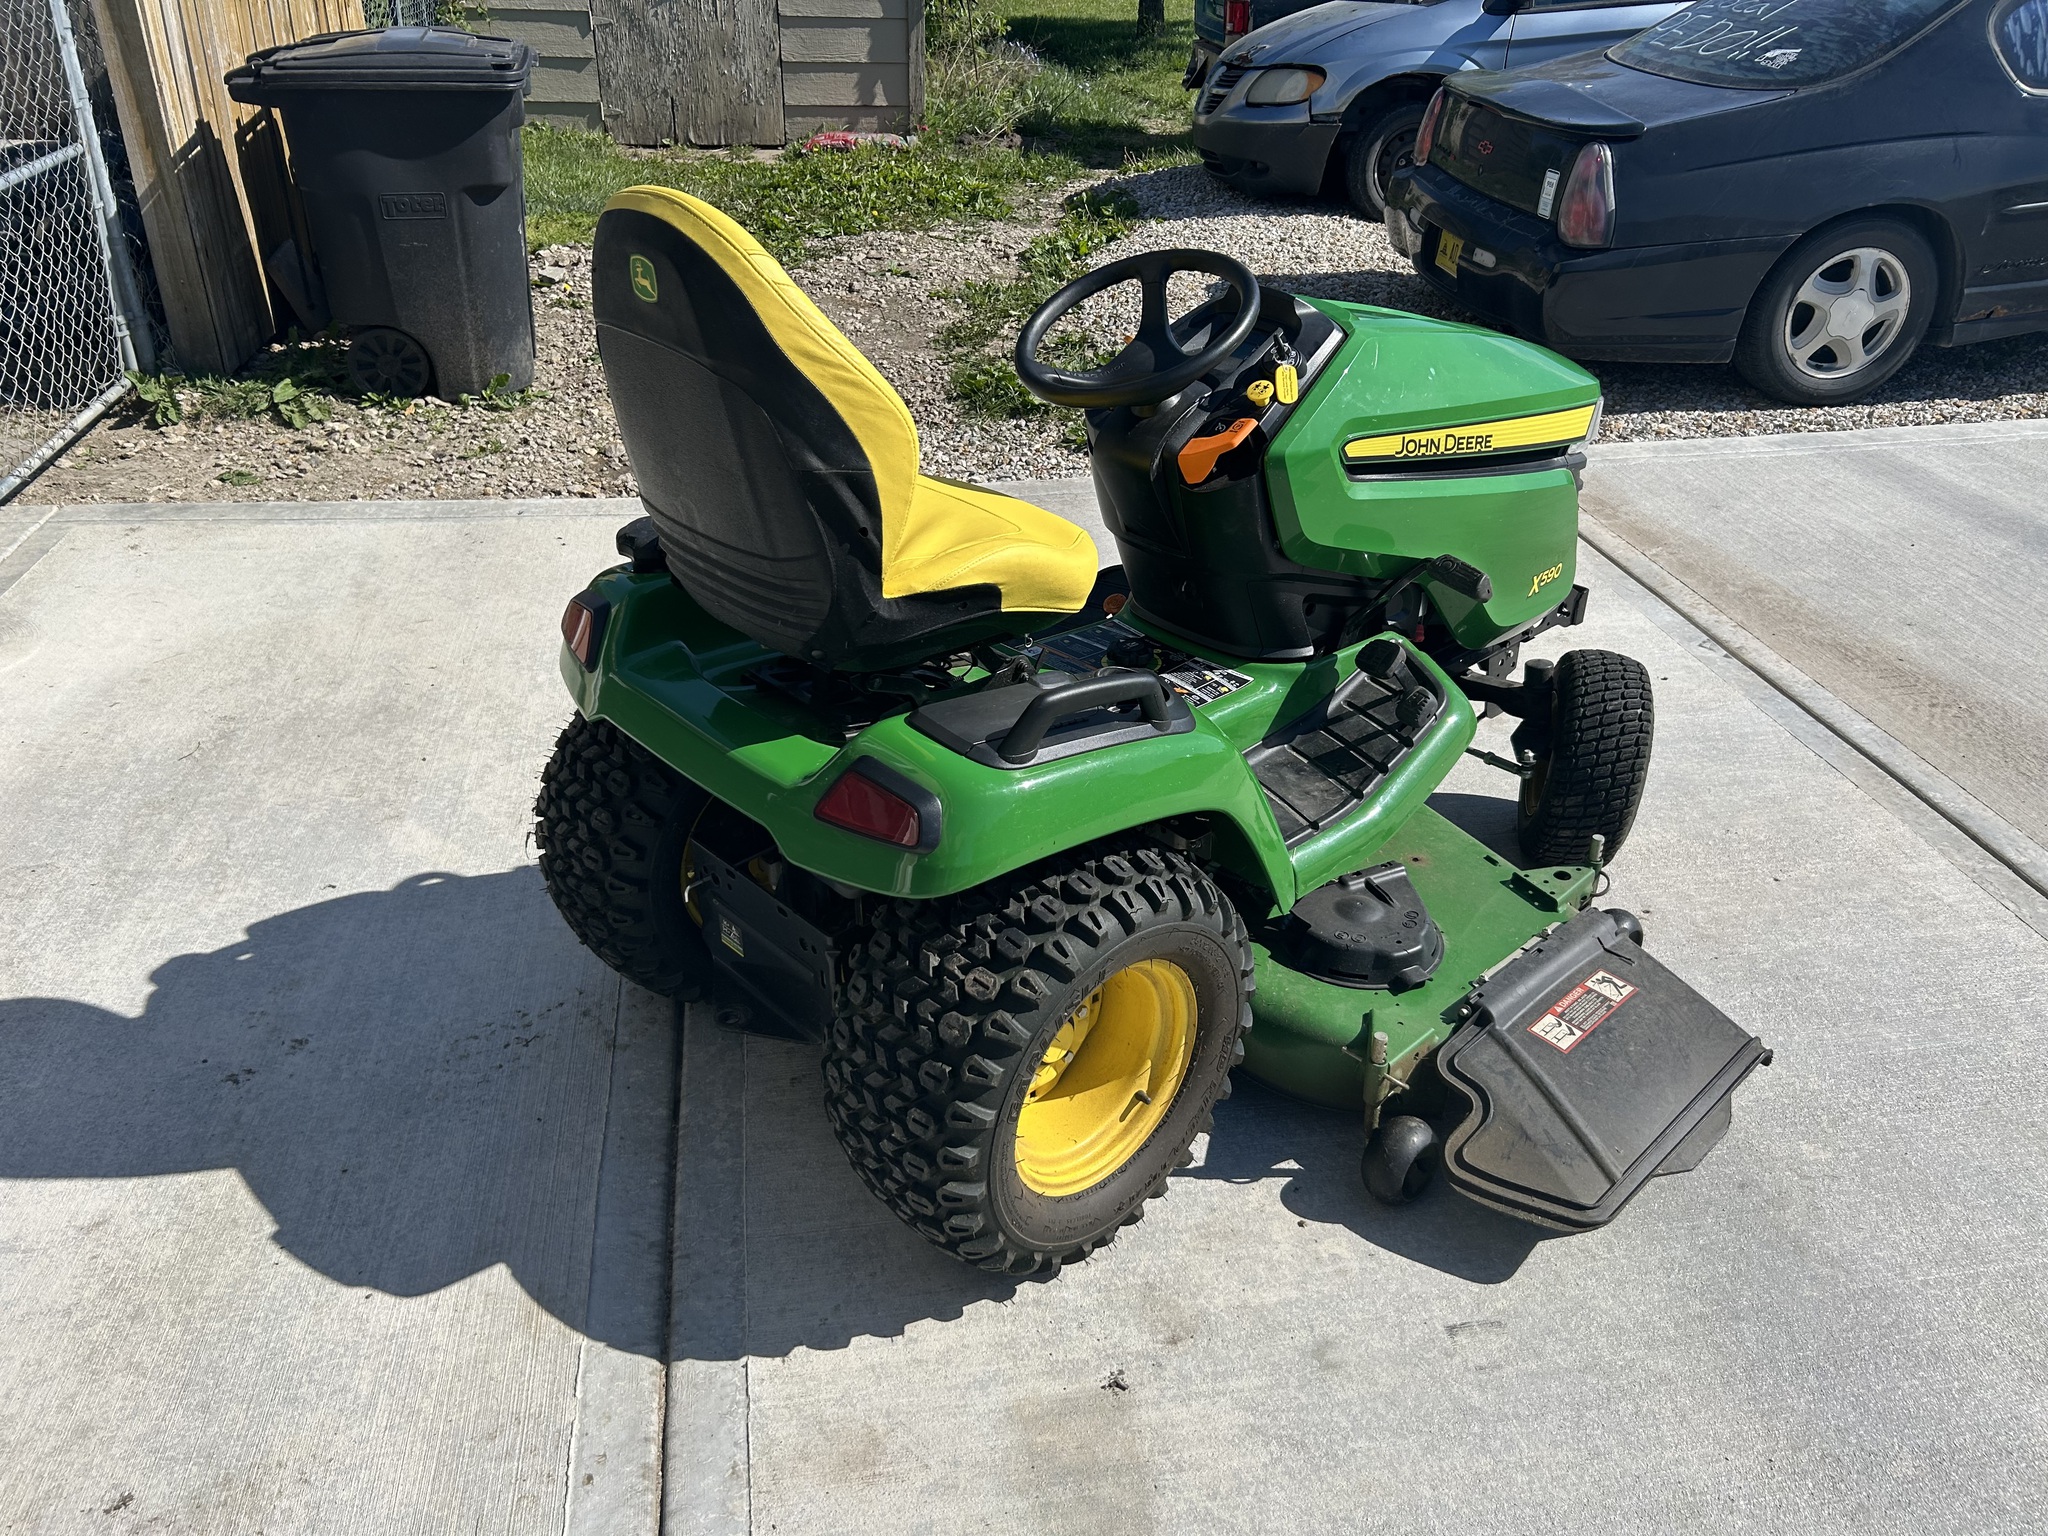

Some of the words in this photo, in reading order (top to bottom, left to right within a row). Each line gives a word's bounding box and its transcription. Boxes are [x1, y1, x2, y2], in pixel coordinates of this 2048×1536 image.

[1394, 435, 1441, 456] JOHN
[1444, 433, 1493, 452] DEERE
[1527, 562, 1563, 598] X590
[1558, 987, 1585, 1008] DANGER
